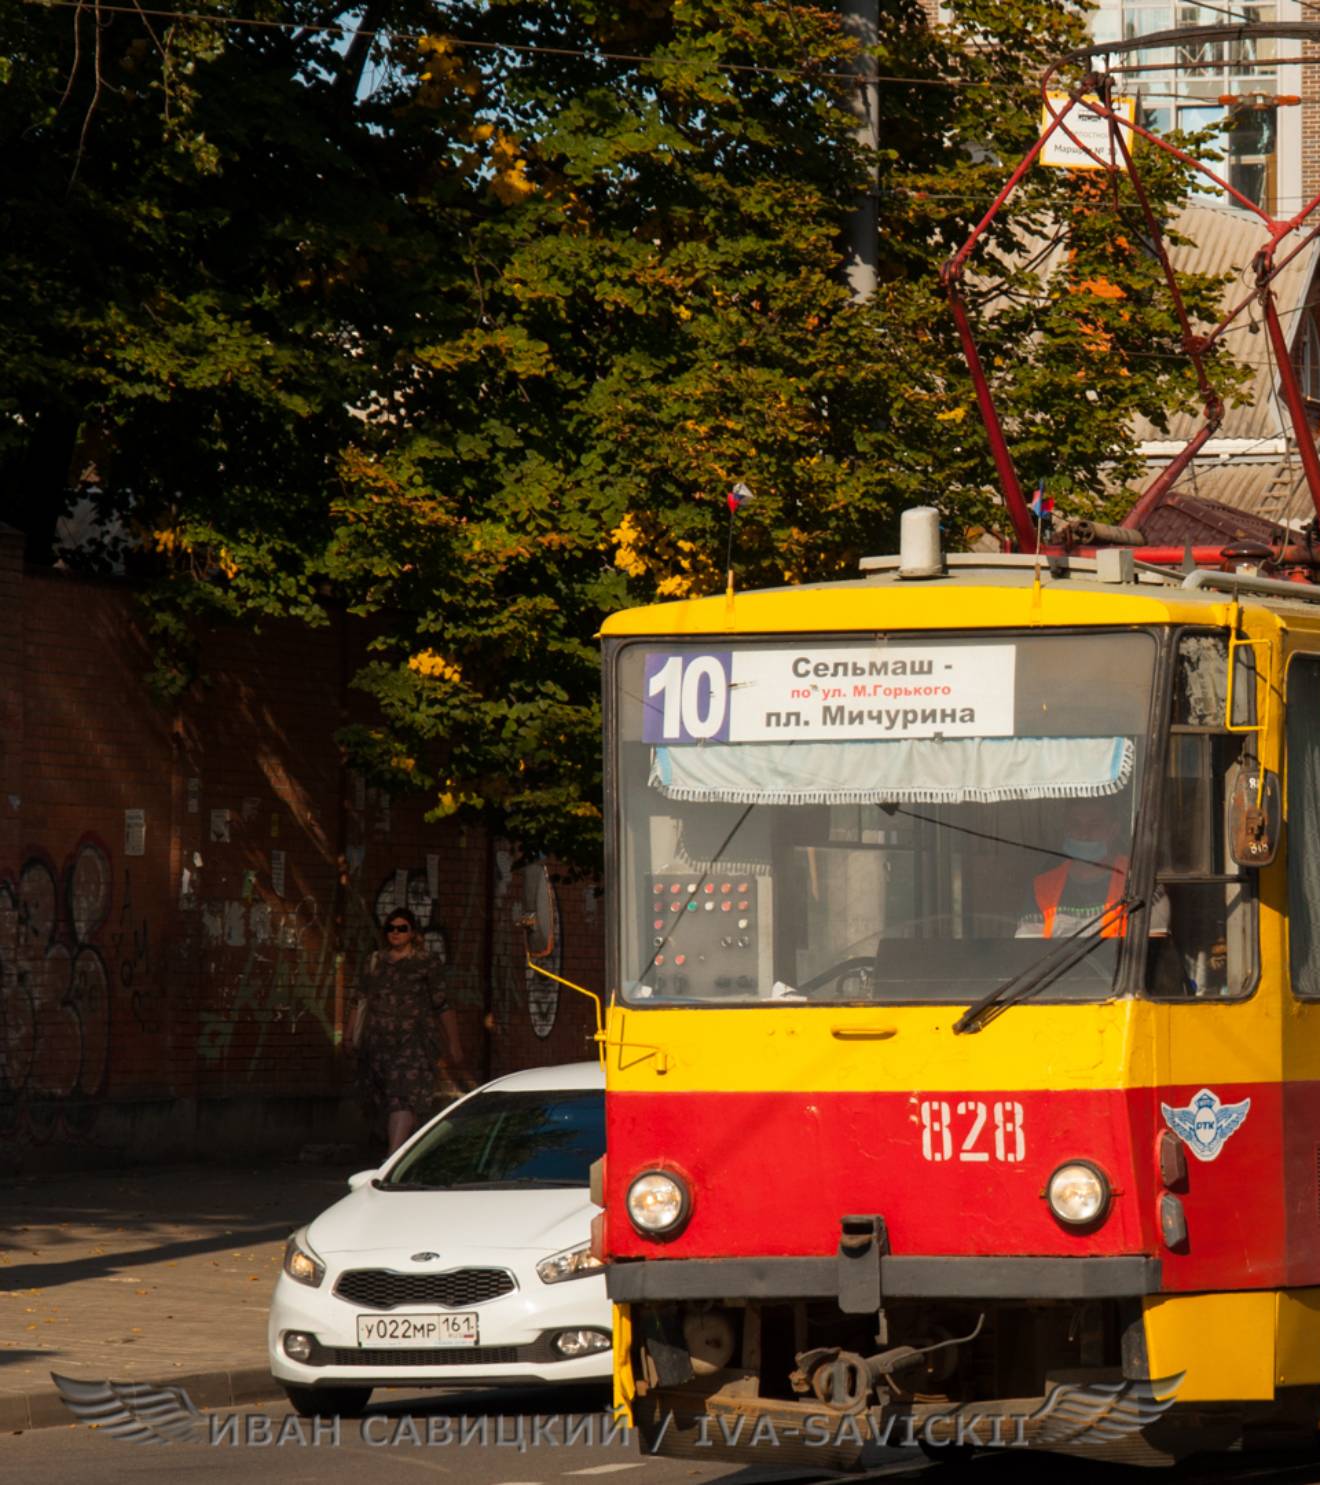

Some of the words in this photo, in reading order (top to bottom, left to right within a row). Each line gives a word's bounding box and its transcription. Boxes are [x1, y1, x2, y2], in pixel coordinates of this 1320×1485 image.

[792, 657, 933, 678] Сельмаш
[649, 655, 727, 739] 10
[791, 688, 811, 699] по
[822, 688, 847, 701] ул.
[853, 684, 952, 699] М.Горького
[765, 711, 810, 727] пл.
[822, 705, 975, 730] Мичурина
[921, 1100, 1026, 1162] 828
[365, 1319, 437, 1339] У022МР
[442, 1317, 472, 1333] 161
